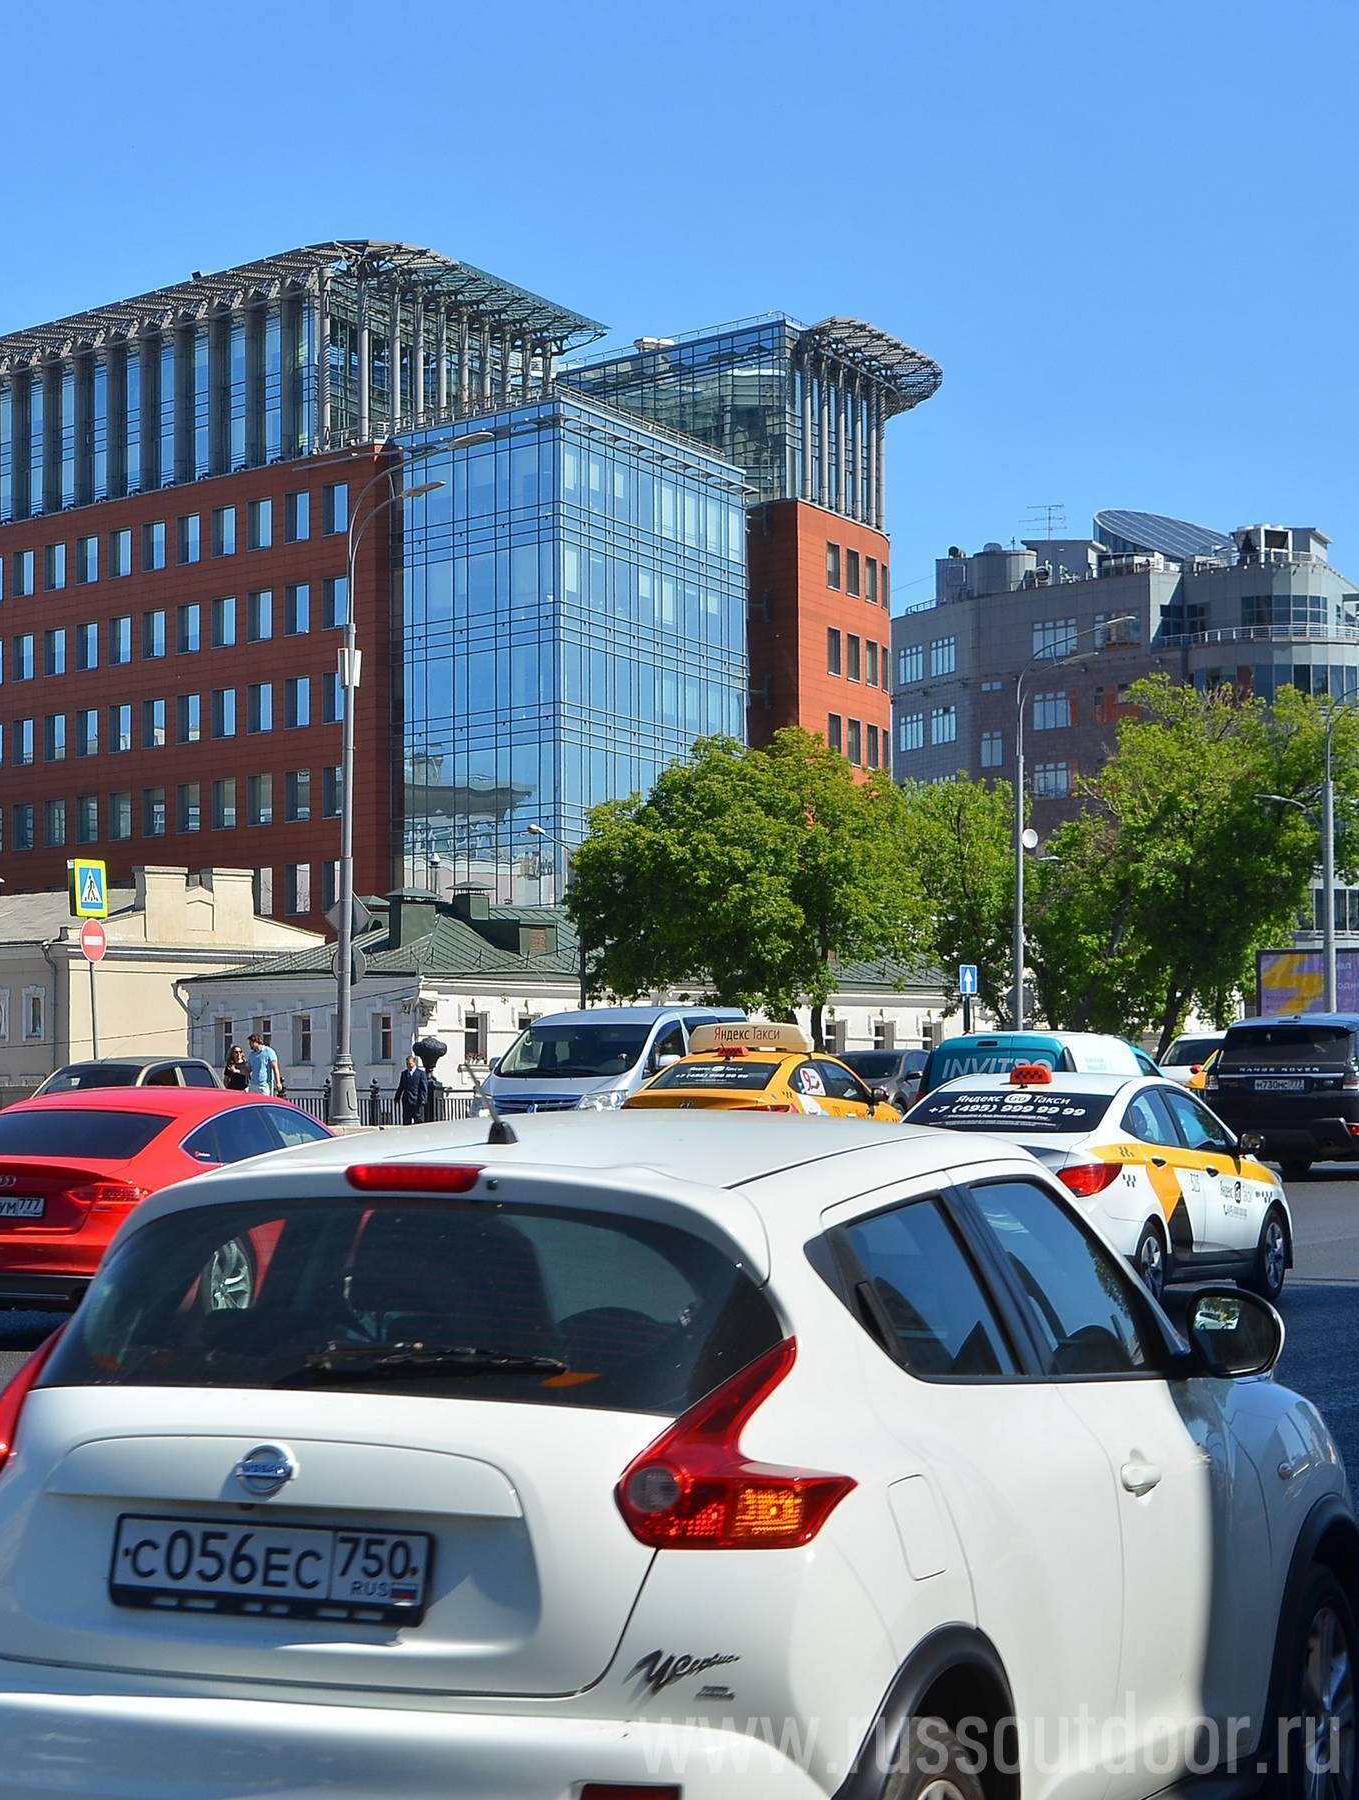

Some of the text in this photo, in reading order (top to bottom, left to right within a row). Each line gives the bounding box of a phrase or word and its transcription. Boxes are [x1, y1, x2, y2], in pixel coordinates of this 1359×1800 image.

[714, 1026, 780, 1041] Яндекс Такси
[955, 1095, 1003, 1104] Яндекс
[1033, 1095, 1071, 1105] Такси
[928, 1105, 950, 1114] +7
[952, 1104, 998, 1114] (495)
[999, 1105, 1034, 1113] 999
[131, 1529, 411, 1590] С056ЕС 750
[350, 1581, 390, 1597] RUS
